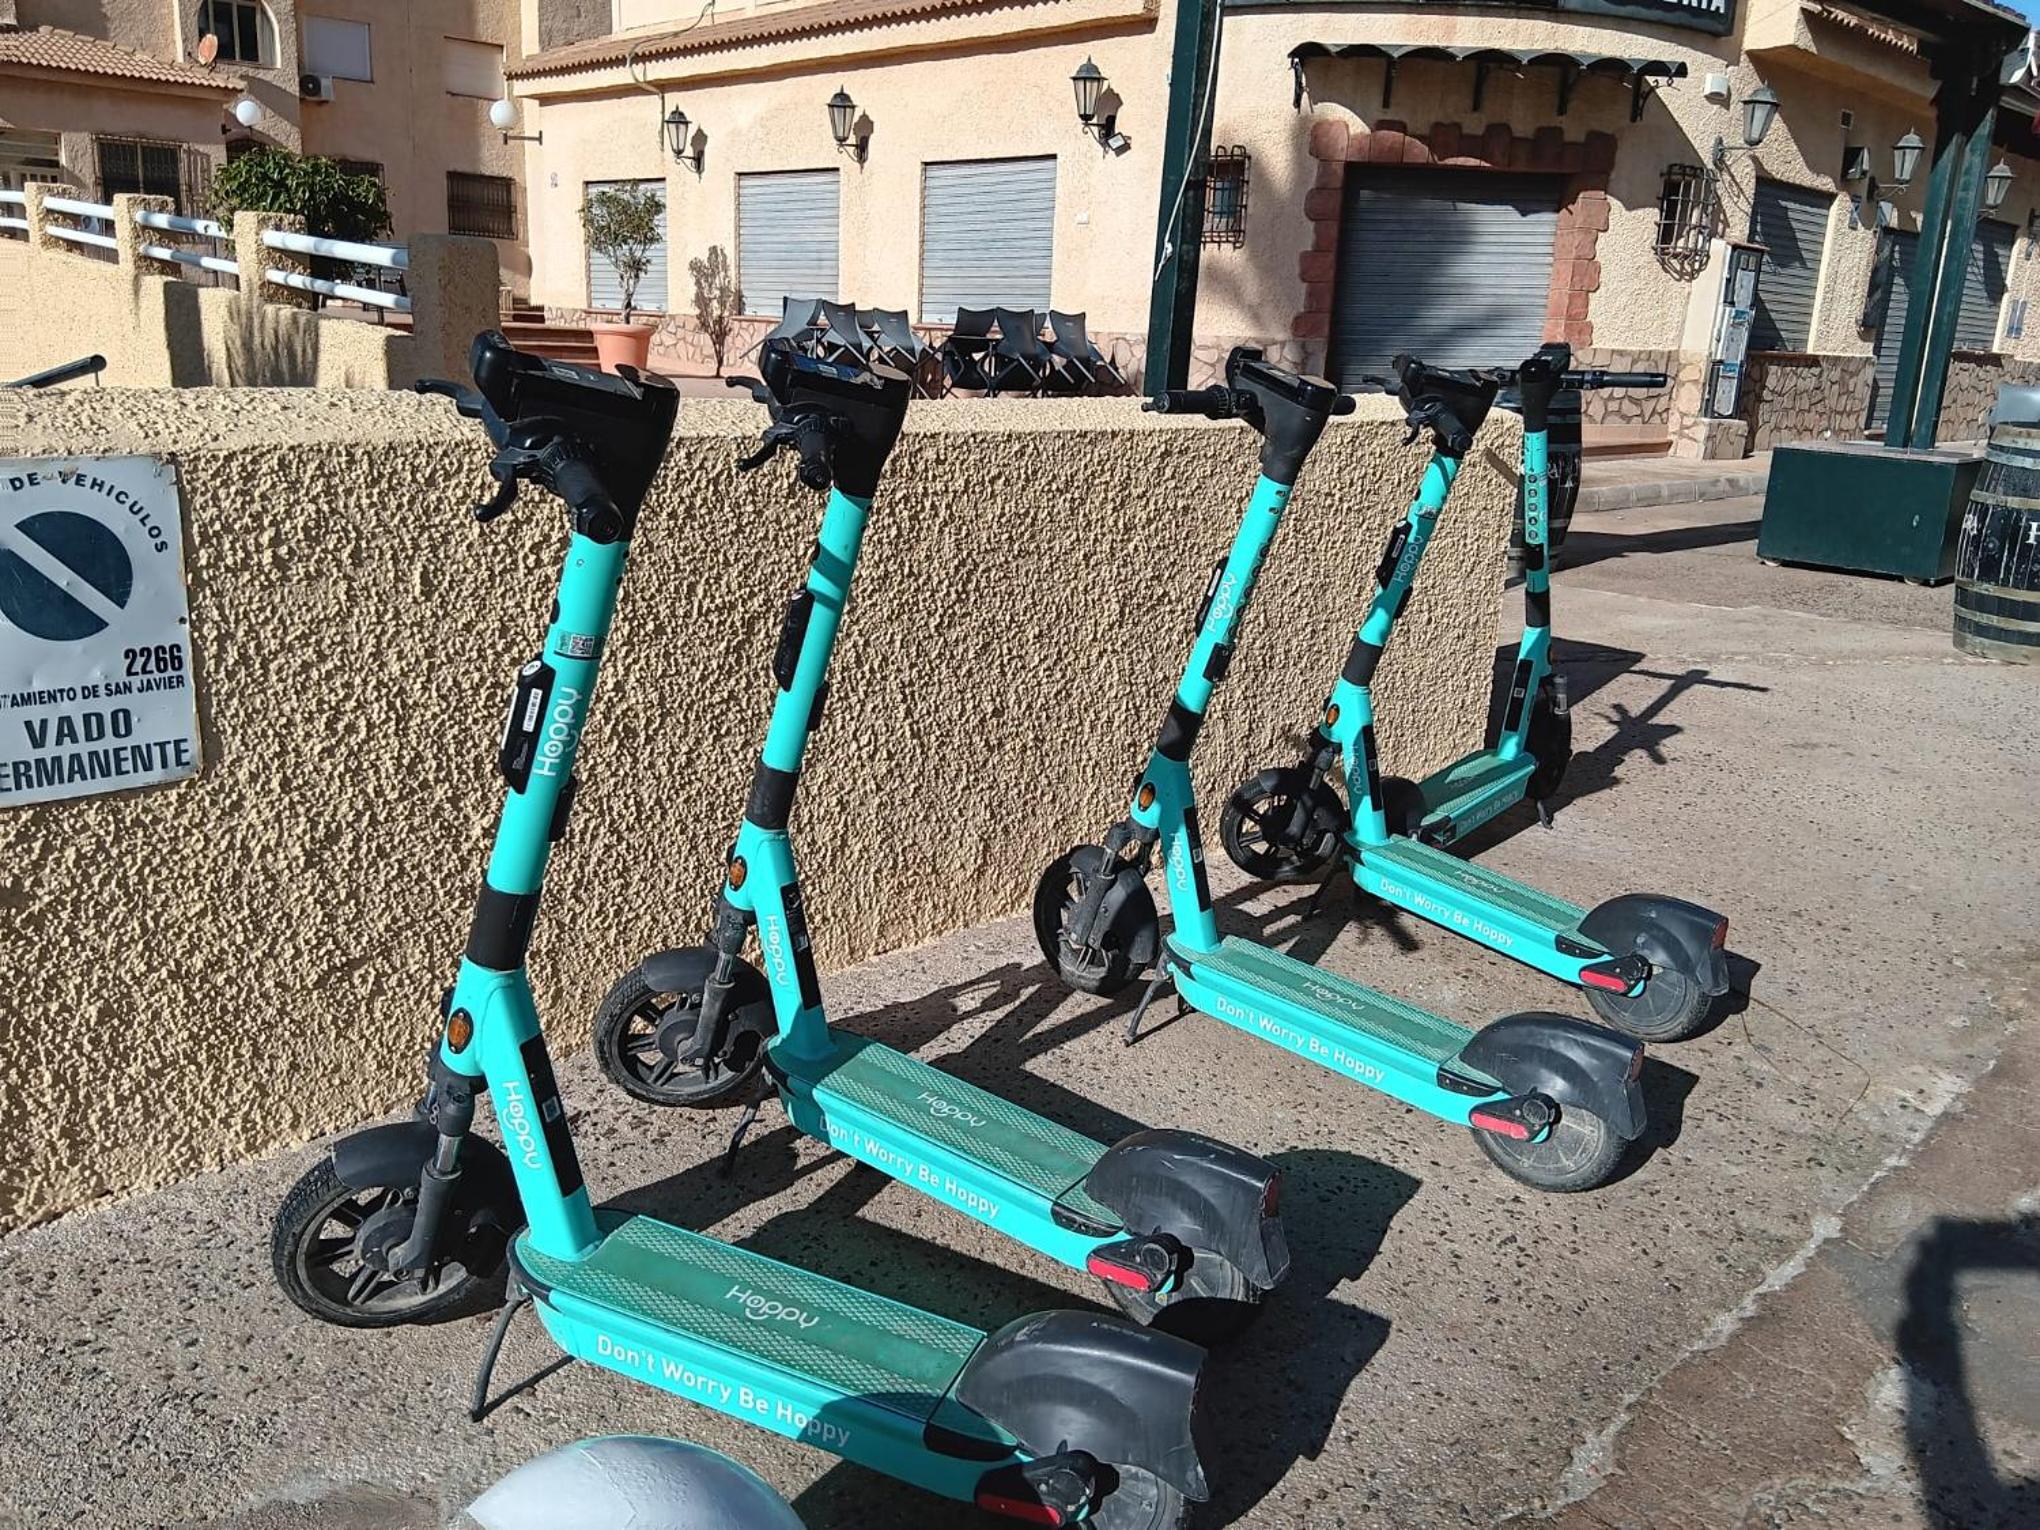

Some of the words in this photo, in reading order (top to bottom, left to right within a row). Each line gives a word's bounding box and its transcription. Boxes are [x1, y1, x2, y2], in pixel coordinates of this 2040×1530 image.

[9, 472, 41, 492] DE
[58, 469, 169, 553] VEHICULOS
[0, 687, 77, 709] TAMIENTO
[81, 685, 100, 700] DE
[104, 681, 133, 697] SAN
[137, 674, 186, 693] JAVIER
[124, 643, 184, 677] 2266
[24, 708, 133, 750] VADO
[532, 686, 584, 777] Hoppy
[1414, 892, 1450, 919] Worry
[1453, 910, 1471, 928] Be
[1473, 920, 1514, 947] Hoppy
[1216, 996, 1256, 1023] Don't
[1258, 1015, 1305, 1048] Worry
[1309, 1036, 1330, 1058] Be
[1333, 1048, 1386, 1083] Hoppy
[502, 1081, 543, 1169] Hoppy
[917, 1091, 987, 1128] Hoppy
[818, 1115, 861, 1148] Don't
[864, 1138, 915, 1176] Worry
[918, 1164, 940, 1188] Be
[945, 1175, 1000, 1219] Hoppy
[724, 1284, 821, 1330] Hoppy
[596, 1334, 655, 1373] Don't
[661, 1356, 733, 1401] Worry
[738, 1385, 769, 1416] Be
[776, 1403, 851, 1449] Hoppy
